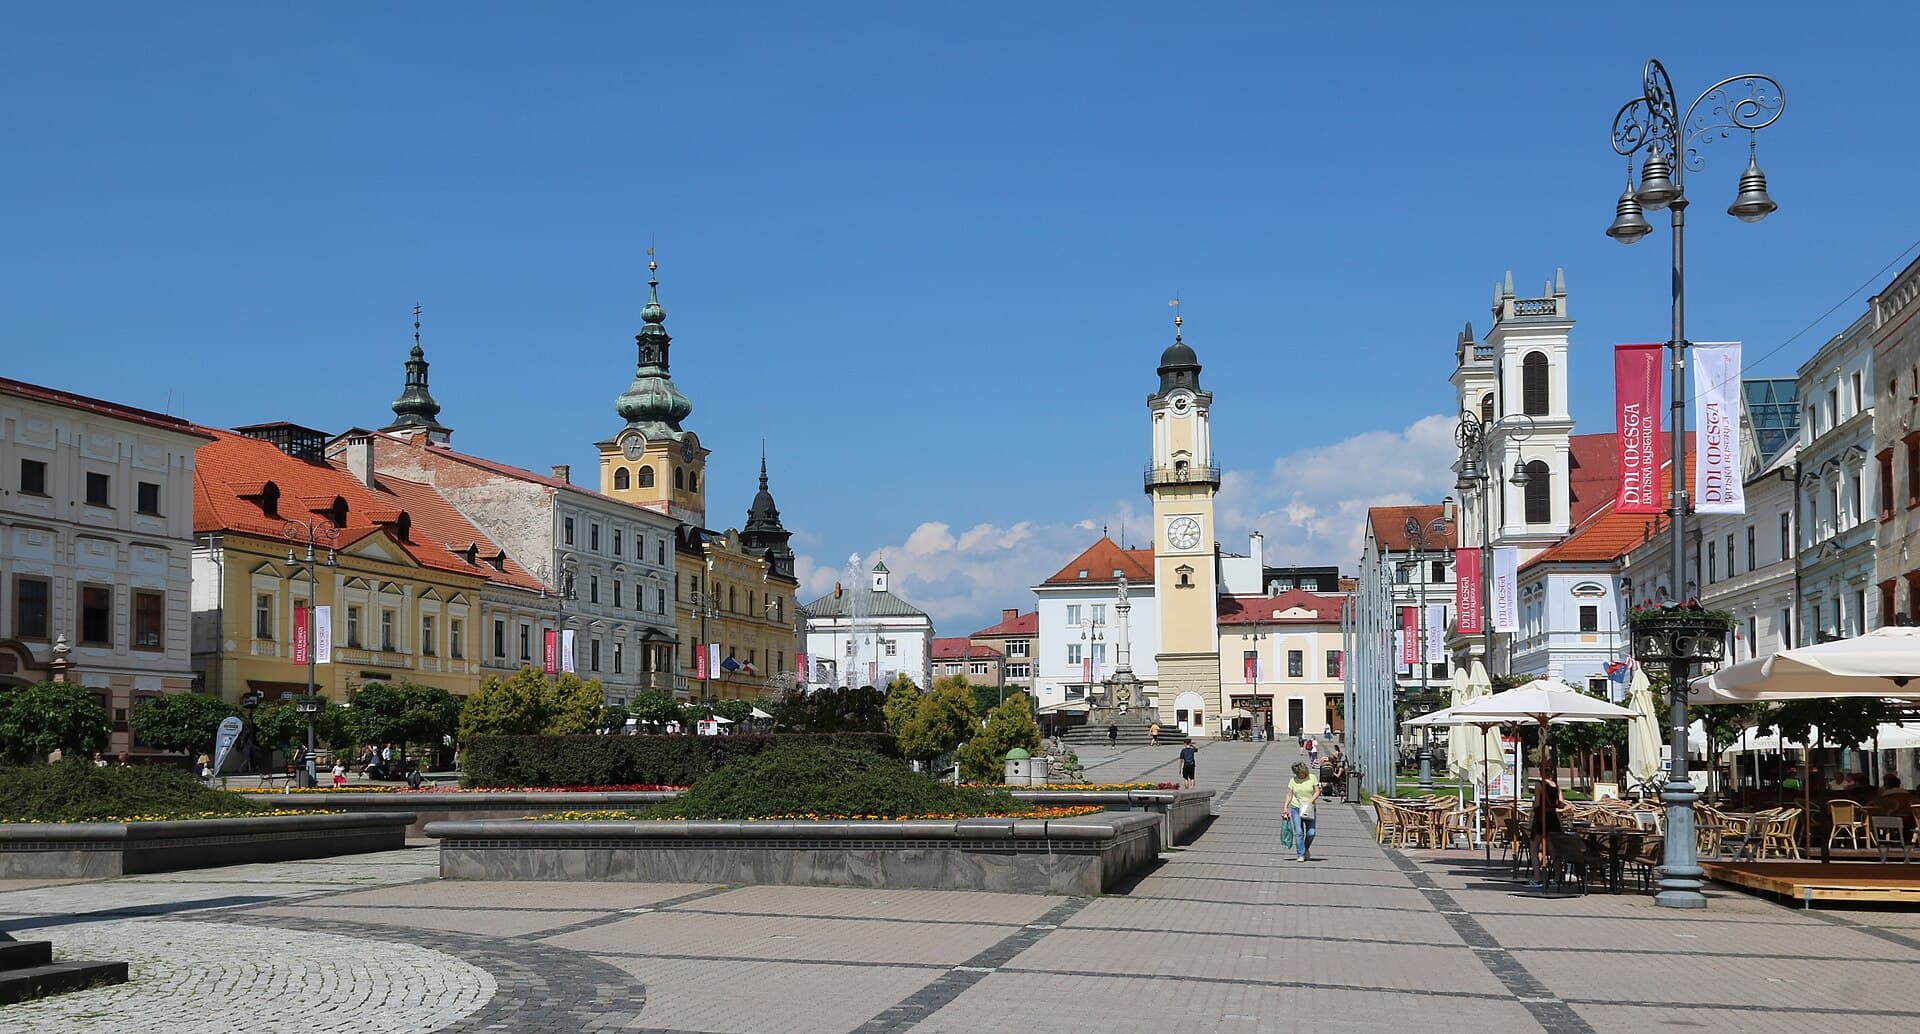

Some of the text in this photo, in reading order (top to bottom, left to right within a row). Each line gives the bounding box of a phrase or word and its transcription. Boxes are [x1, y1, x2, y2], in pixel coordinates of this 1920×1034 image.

[1624, 403, 1640, 504] DNI MESTA
[1642, 416, 1653, 464] BYSTRICA
[1705, 402, 1721, 503] DNI MESTA
[1461, 576, 1470, 628] DNI MESTA
